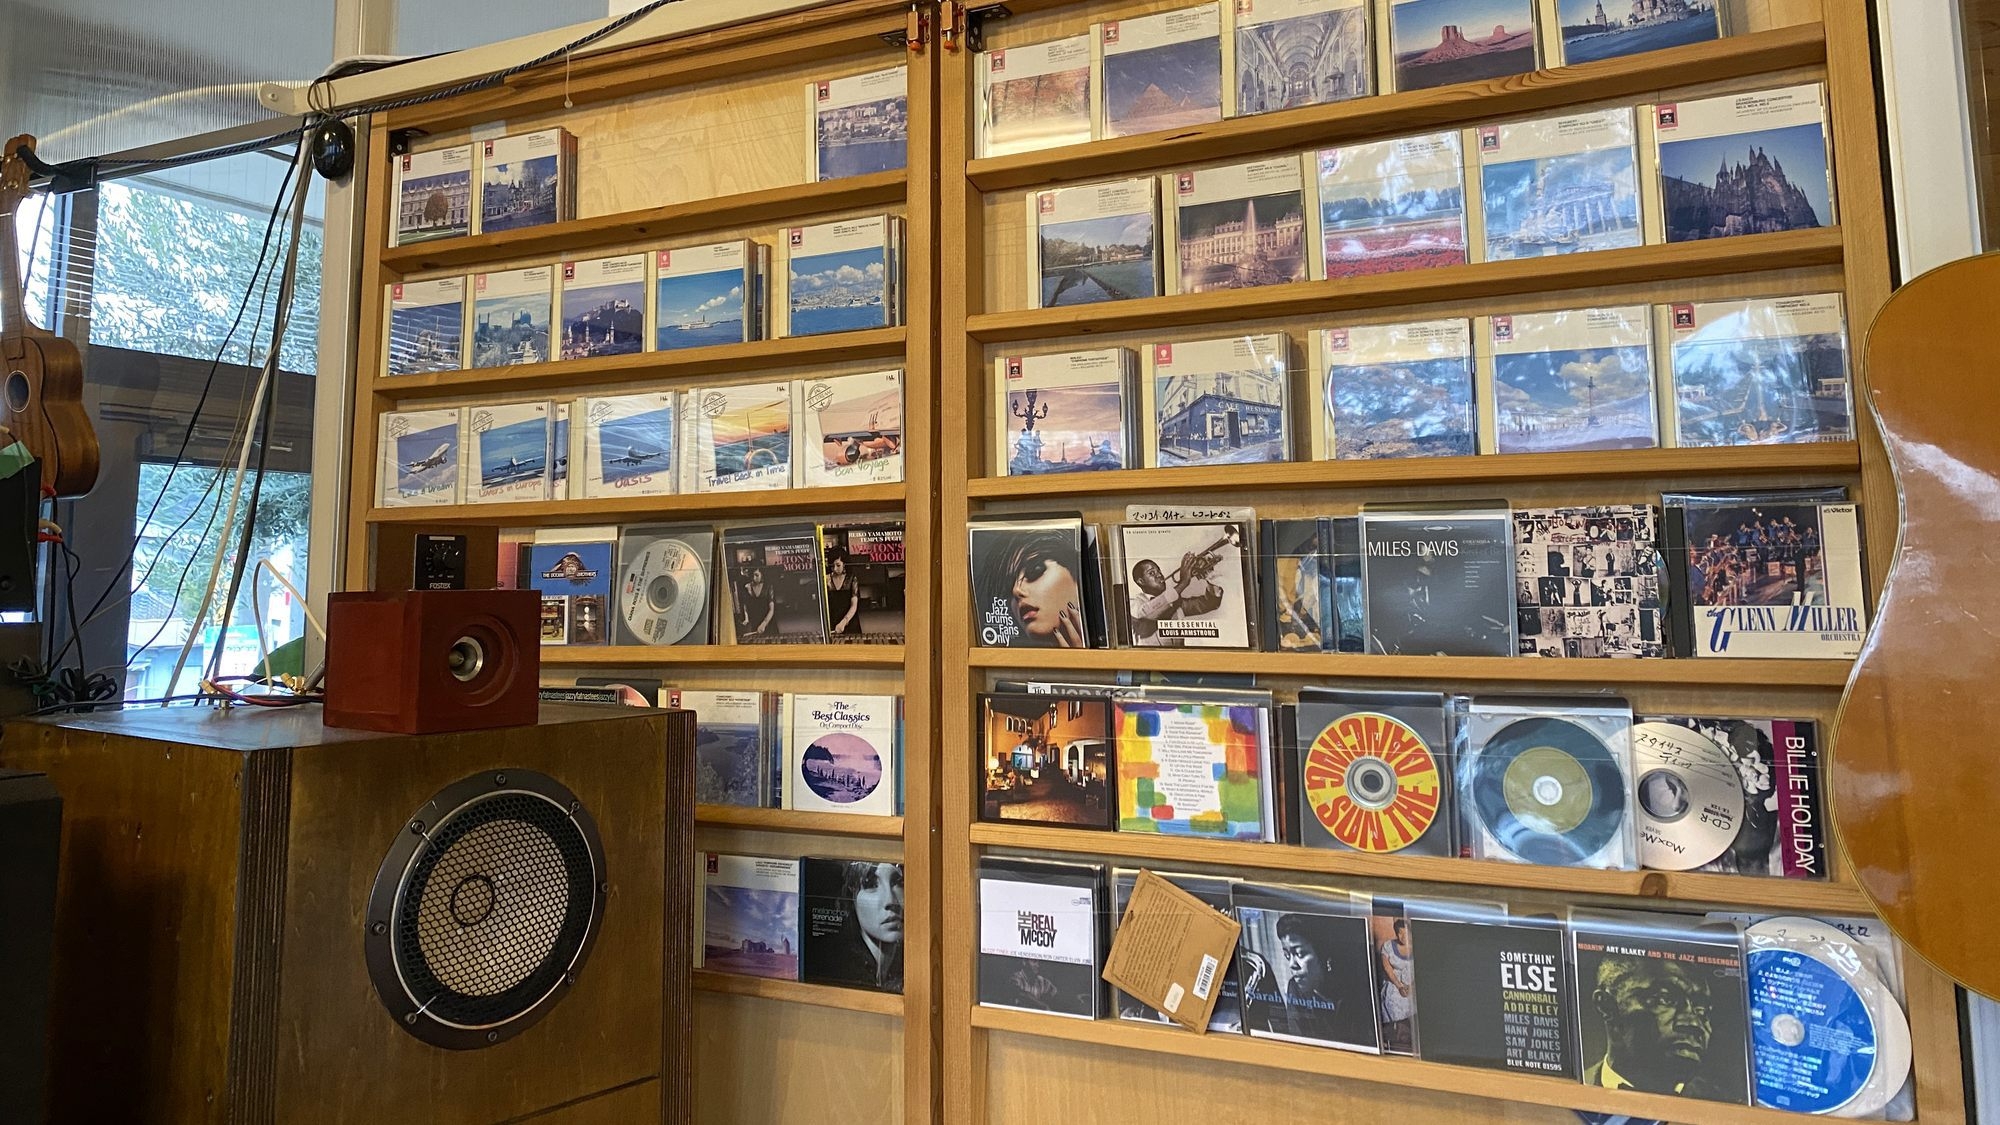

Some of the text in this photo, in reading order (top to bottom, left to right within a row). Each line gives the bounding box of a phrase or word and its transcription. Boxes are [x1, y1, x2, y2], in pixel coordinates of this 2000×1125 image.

[834, 457, 890, 476] Bon Voyage
[706, 464, 786, 488] Travel Back in Time
[478, 487, 504, 498] Lovers
[514, 480, 542, 492] Europe
[851, 543, 905, 555] WILTON'S
[1368, 540, 1458, 558] MILES DAVIS
[640, 551, 651, 577] SUPREMES
[870, 552, 904, 562] MOOD
[994, 596, 1008, 607] For
[991, 604, 1008, 616] Jazz
[986, 612, 1014, 626] Drums
[1706, 590, 1860, 653] the GLENN MILLER
[982, 626, 1010, 647] Only
[998, 624, 1019, 636] Fans
[1821, 634, 1860, 642] ORCHESTRA
[834, 701, 850, 710] The
[812, 710, 870, 722] Best Classics
[1785, 736, 1816, 874] BILLIE HOLIDAY
[1700, 812, 1731, 830] CD-R
[1640, 831, 1686, 854] MaxMe
[1018, 910, 1032, 932] THE
[1031, 914, 1058, 932] REAL
[1500, 951, 1555, 965] SOMETHIN'
[1606, 946, 1618, 954] ART
[1620, 946, 1646, 956] BLAKEY
[1663, 952, 1676, 960] THE
[1678, 953, 1695, 962] JAZZ
[1500, 963, 1558, 992] ELSE
[1250, 989, 1282, 1003] Sarah
[1503, 990, 1558, 1005] CANNONBALL
[1504, 1002, 1559, 1016] ADDERLEY
[1504, 1013, 1560, 1028] MILES DAVIS
[1504, 1024, 1560, 1040] HANK JONES
[1505, 1036, 1561, 1050] SAM JONES
[1506, 1048, 1562, 1062] ART BLAKEY
[1506, 1058, 1523, 1066] BLUE
[1524, 1060, 1542, 1068] NOTE
